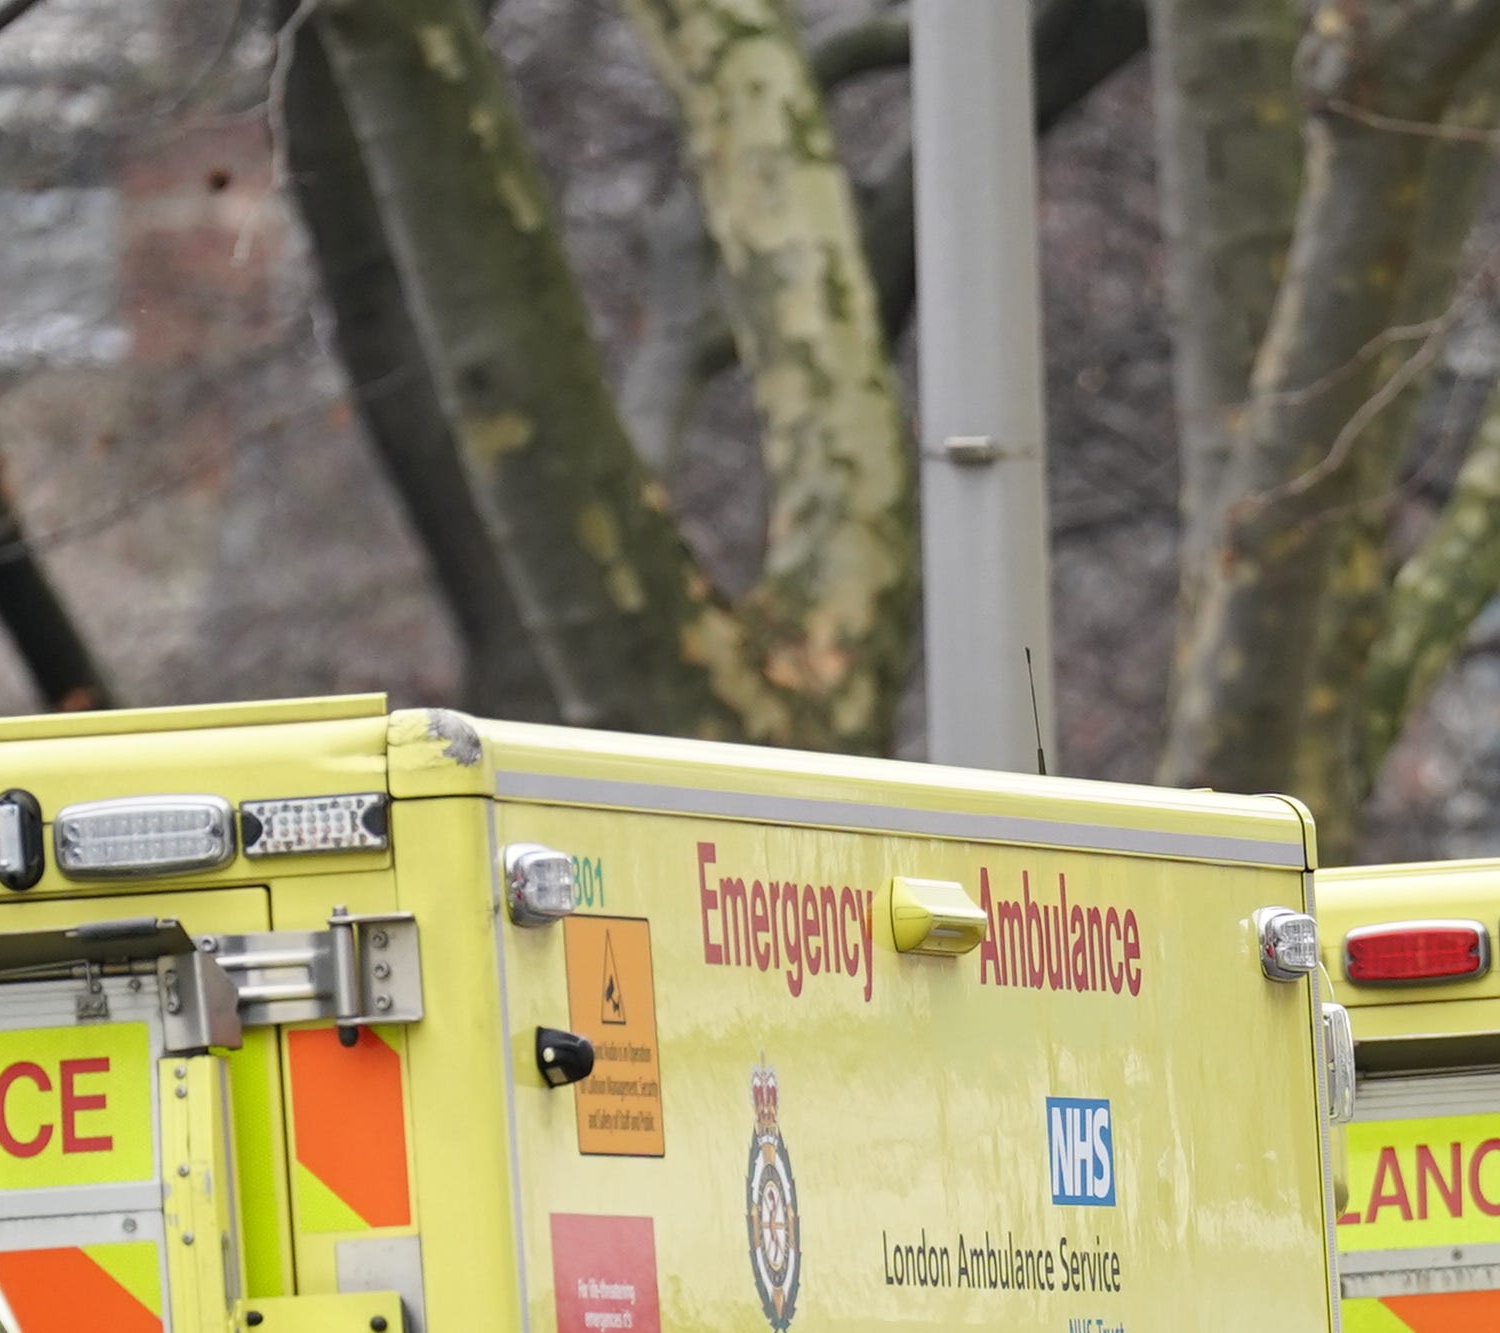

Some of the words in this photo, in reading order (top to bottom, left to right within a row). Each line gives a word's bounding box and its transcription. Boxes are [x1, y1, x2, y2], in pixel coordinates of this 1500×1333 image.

[697, 842, 873, 1002] Emergency
[979, 866, 1141, 996] Ambulance
[1050, 1106, 1109, 1199] NHS
[883, 1228, 952, 1290] London
[957, 1231, 1055, 1291] Ambulance
[1061, 1235, 1121, 1292] Service
